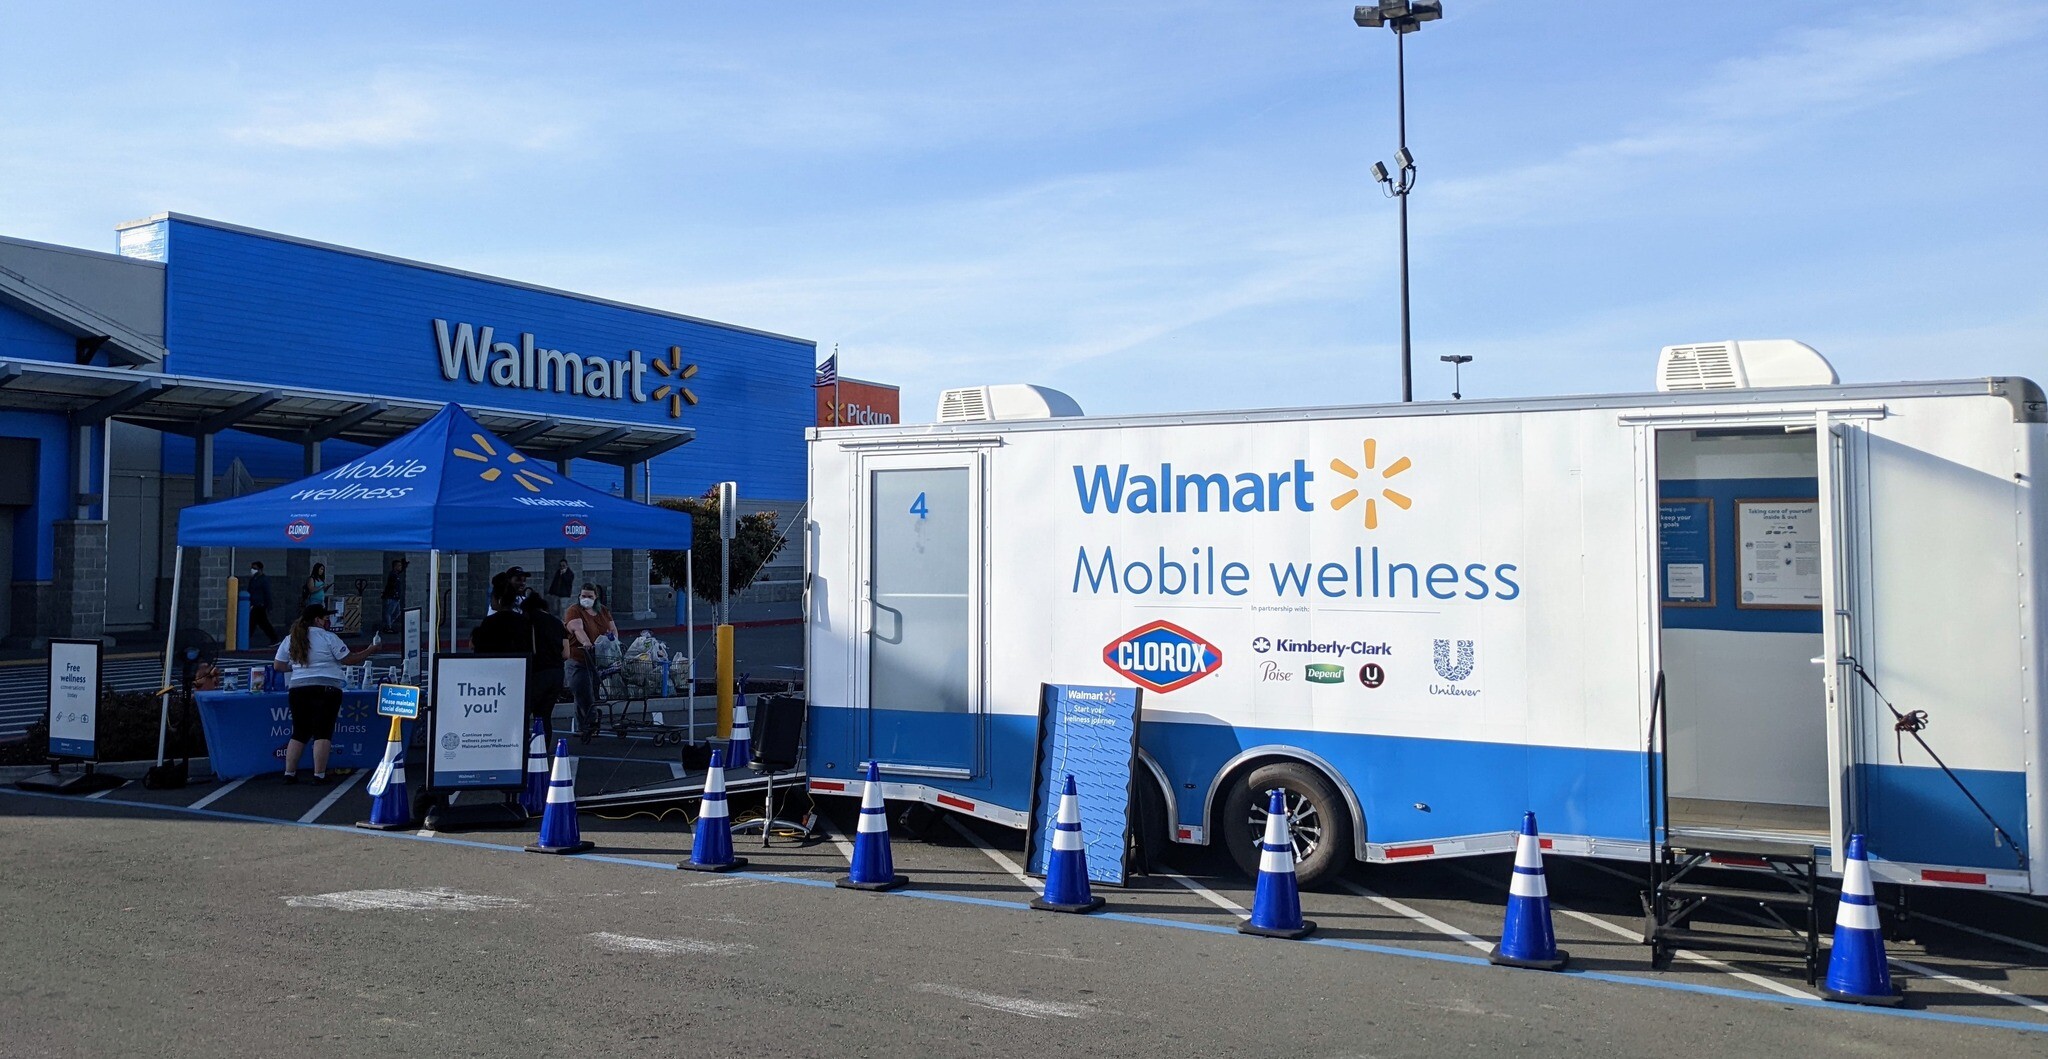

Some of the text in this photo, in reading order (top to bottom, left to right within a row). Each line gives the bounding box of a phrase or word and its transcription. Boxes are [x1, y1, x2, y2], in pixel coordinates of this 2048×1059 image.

[434, 319, 647, 402] Walmart
[847, 403, 892, 425] Pickup
[323, 459, 427, 480] Mobile
[290, 483, 414, 500] wellness
[1073, 459, 1315, 514] Walmart
[512, 497, 594, 508] Walmart
[910, 492, 929, 519] 4
[1748, 508, 1767, 516] Taking
[288, 525, 310, 535] CLOROX
[565, 525, 587, 535] CLOROX
[1072, 545, 1521, 600] Mobile wellness
[1258, 605, 1293, 613] partnership
[1277, 639, 1392, 657] Kimberly-Clark
[1118, 641, 1207, 673] CLOROX
[66, 663, 80, 672] Free
[1260, 660, 1293, 682] Poise
[60, 673, 86, 683] wellness
[1308, 668, 1342, 680] Depend
[457, 682, 507, 696] Thank
[1429, 684, 1481, 696] Unilever
[1068, 690, 1103, 701] Walmart
[381, 697, 415, 707] Please maintain
[395, 706, 414, 714] distance
[464, 699, 498, 718] you!
[1073, 704, 1106, 714] Start your
[1091, 716, 1116, 726] journey
[334, 722, 367, 733] llness
